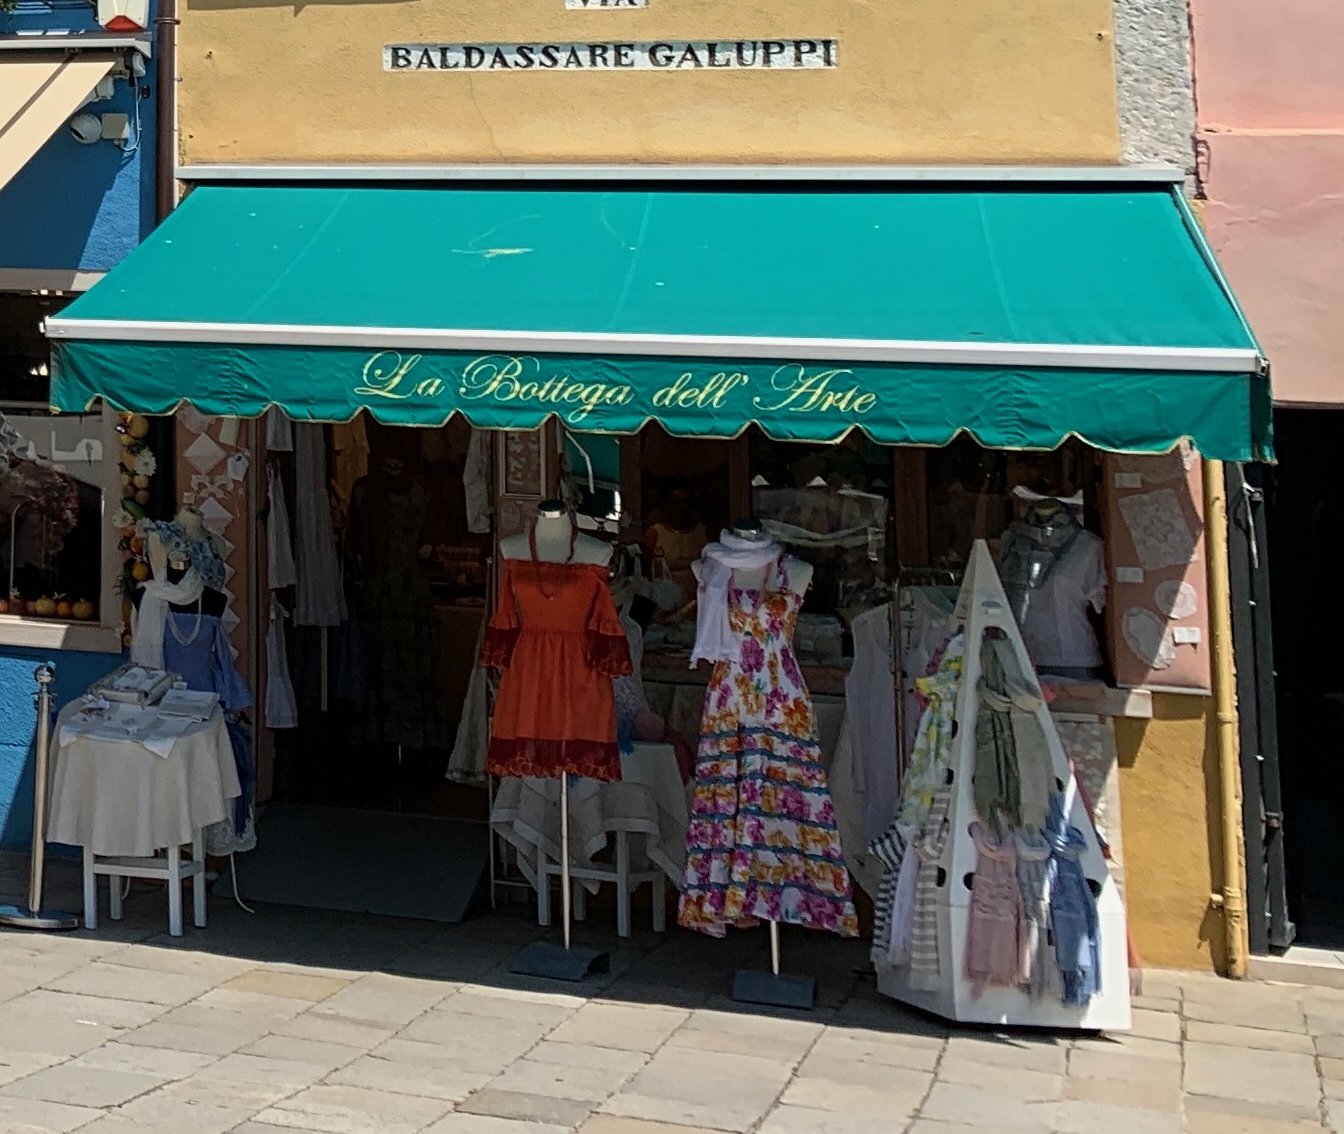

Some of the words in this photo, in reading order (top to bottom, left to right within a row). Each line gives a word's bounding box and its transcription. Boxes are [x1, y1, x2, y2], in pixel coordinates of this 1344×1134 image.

[390, 43, 635, 69] BALDASSARE
[648, 39, 833, 67] GALUPPI
[354, 350, 445, 399] La
[459, 353, 635, 423] Bottega
[652, 372, 749, 409] dell'
[752, 363, 877, 413] Arte
